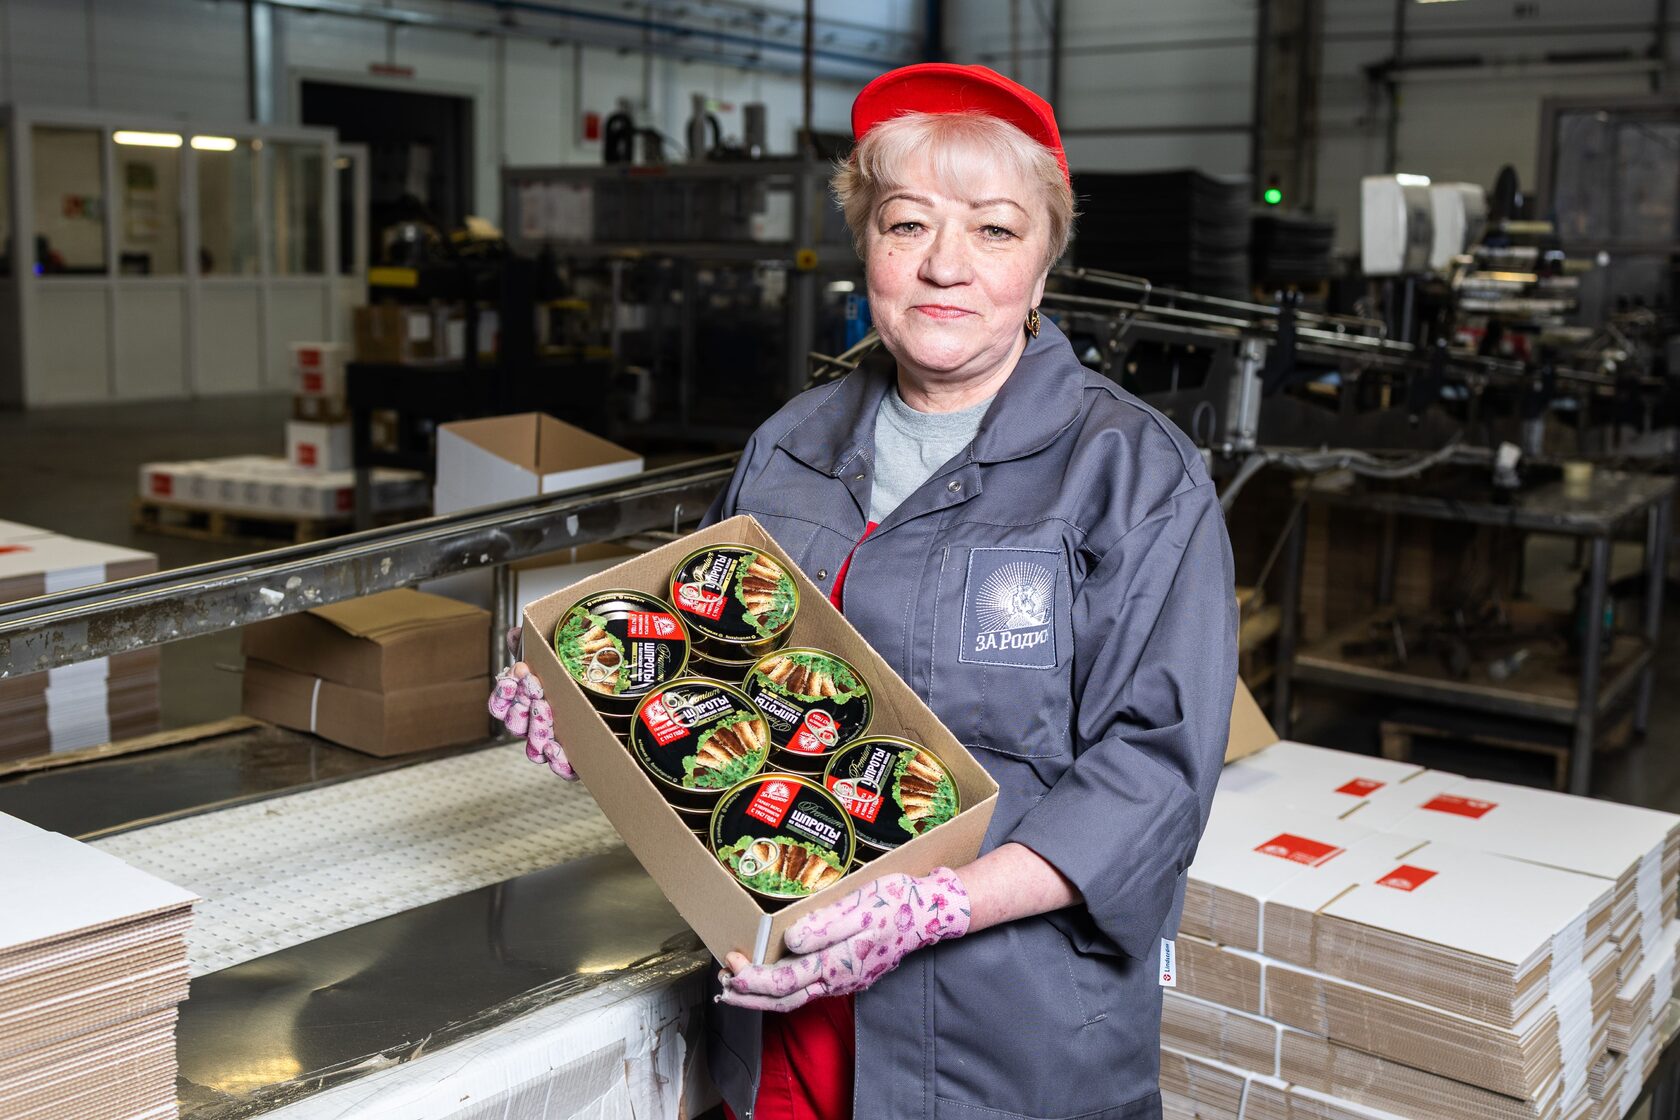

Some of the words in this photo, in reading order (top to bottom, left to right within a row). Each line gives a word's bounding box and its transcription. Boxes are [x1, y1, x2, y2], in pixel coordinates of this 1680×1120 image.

[643, 642, 654, 682] ШПРОТЫ
[754, 696, 798, 724] ШПРОТЫ
[849, 744, 872, 779] Premium
[861, 747, 885, 786] ШПРОТЫ
[791, 810, 841, 840] ШПРОТЫ
[798, 801, 845, 828] Premium
